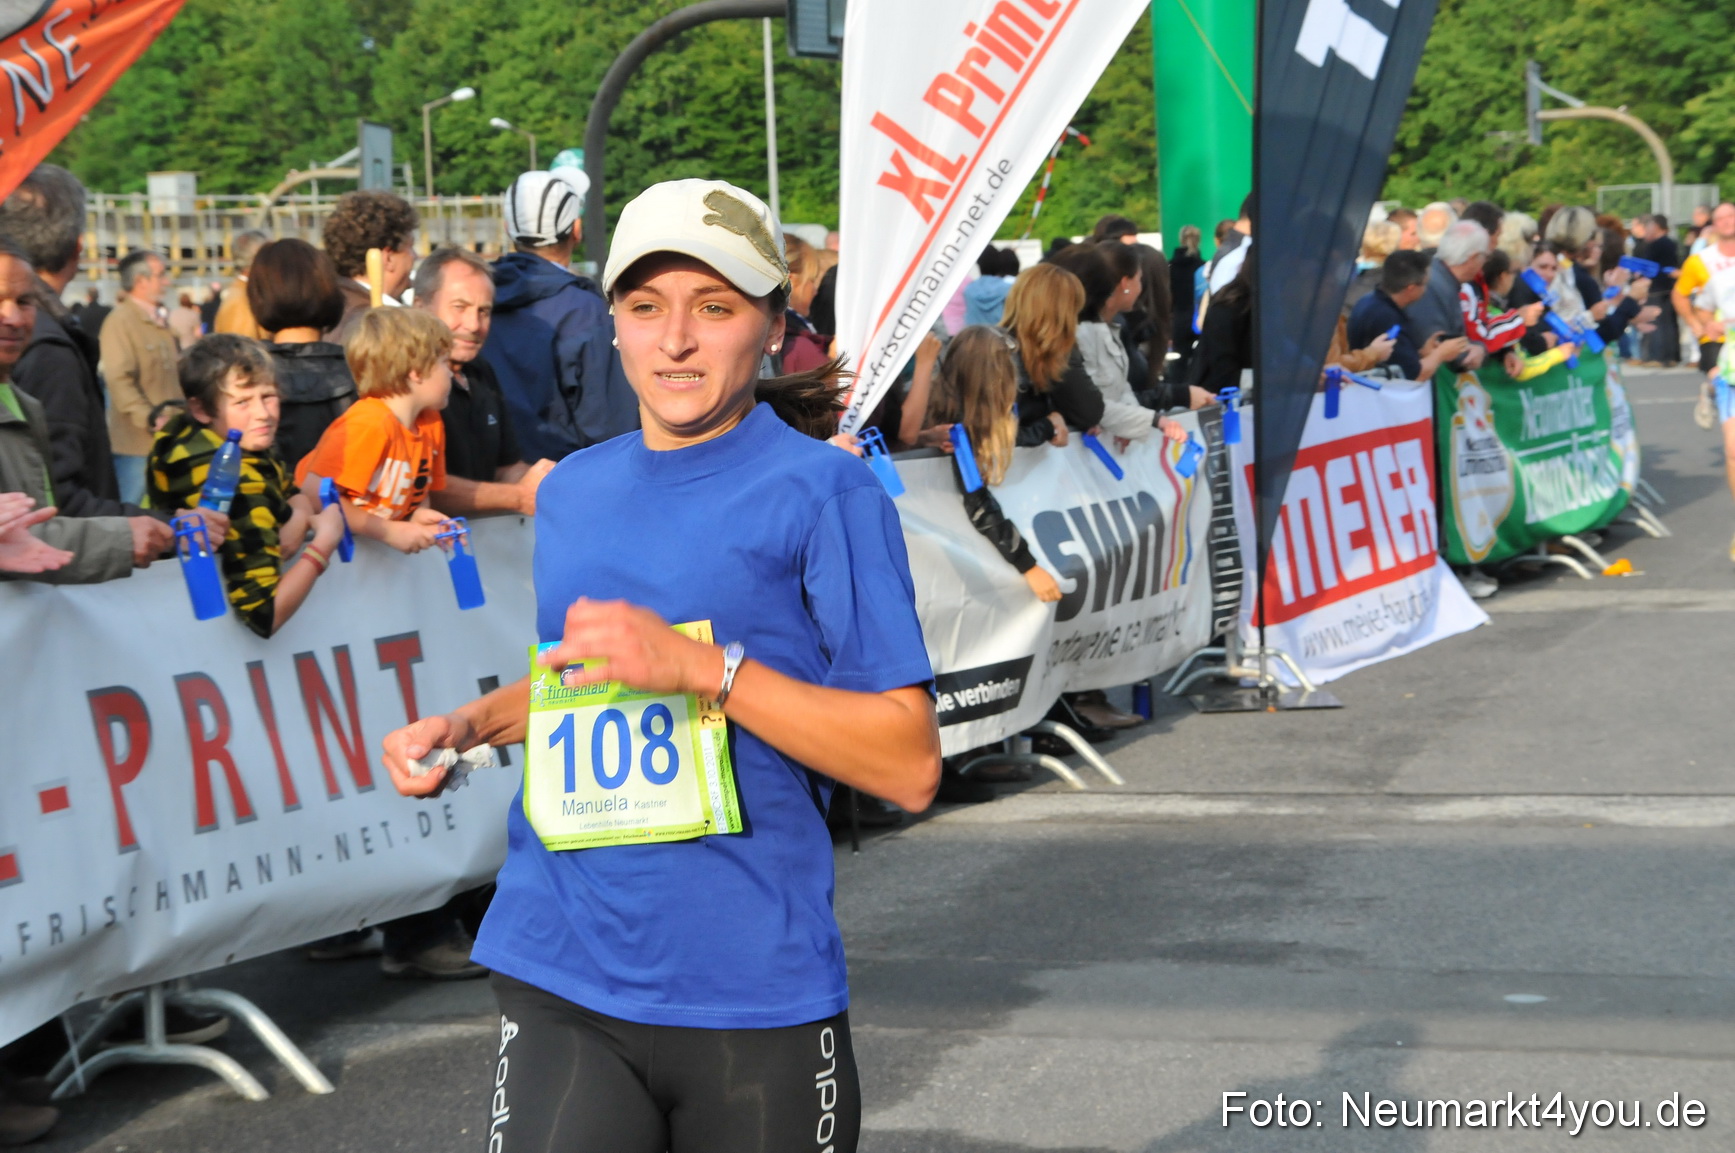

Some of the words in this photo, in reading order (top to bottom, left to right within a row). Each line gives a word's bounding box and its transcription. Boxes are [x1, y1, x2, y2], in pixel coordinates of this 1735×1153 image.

[547, 680, 611, 700] firmenlauf
[549, 703, 679, 793] 108
[562, 794, 629, 816] Manuela
[634, 799, 667, 810] Kastner
[815, 1027, 838, 1144] odlo
